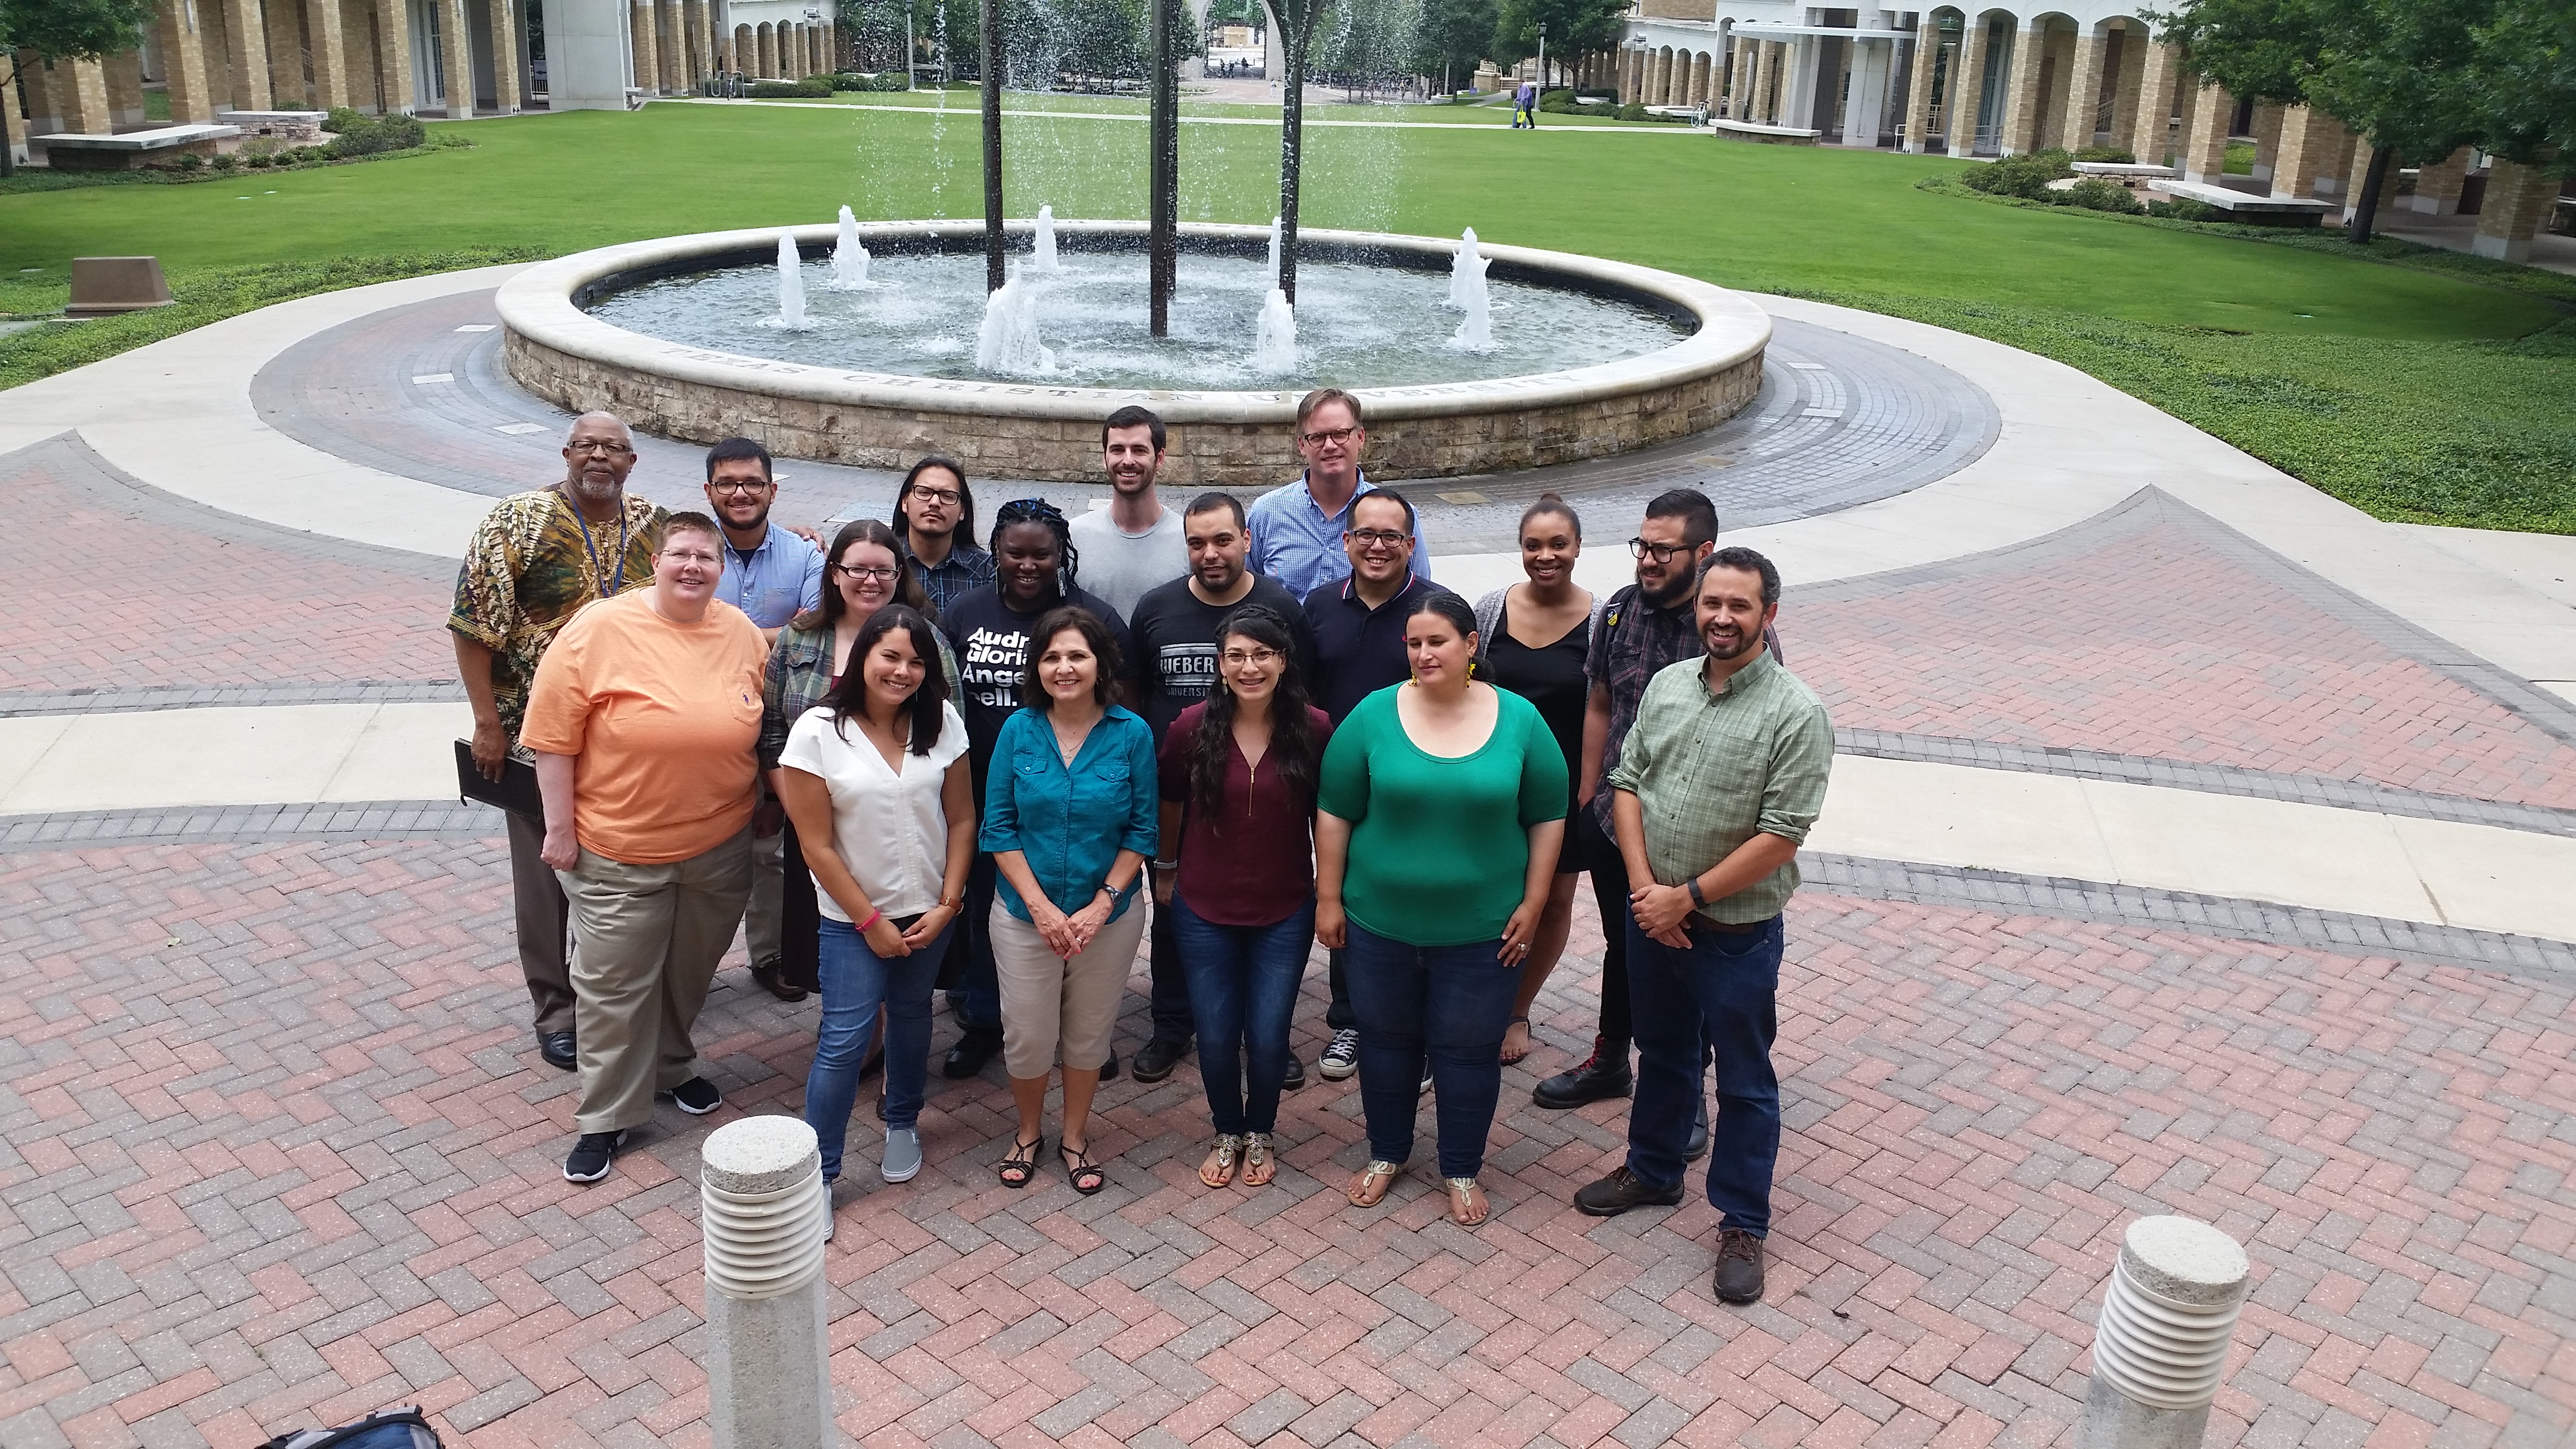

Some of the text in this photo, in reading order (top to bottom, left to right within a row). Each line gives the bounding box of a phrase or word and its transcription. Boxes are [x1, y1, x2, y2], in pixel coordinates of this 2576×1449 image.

[660, 348, 1583, 401] TEXAS CHRISTIAN UVERSITY
[967, 626, 1031, 648] Audr
[962, 663, 1025, 687] Ange
[1160, 656, 1215, 674] WEBER
[1167, 688, 1211, 697] UNIVERSIT
